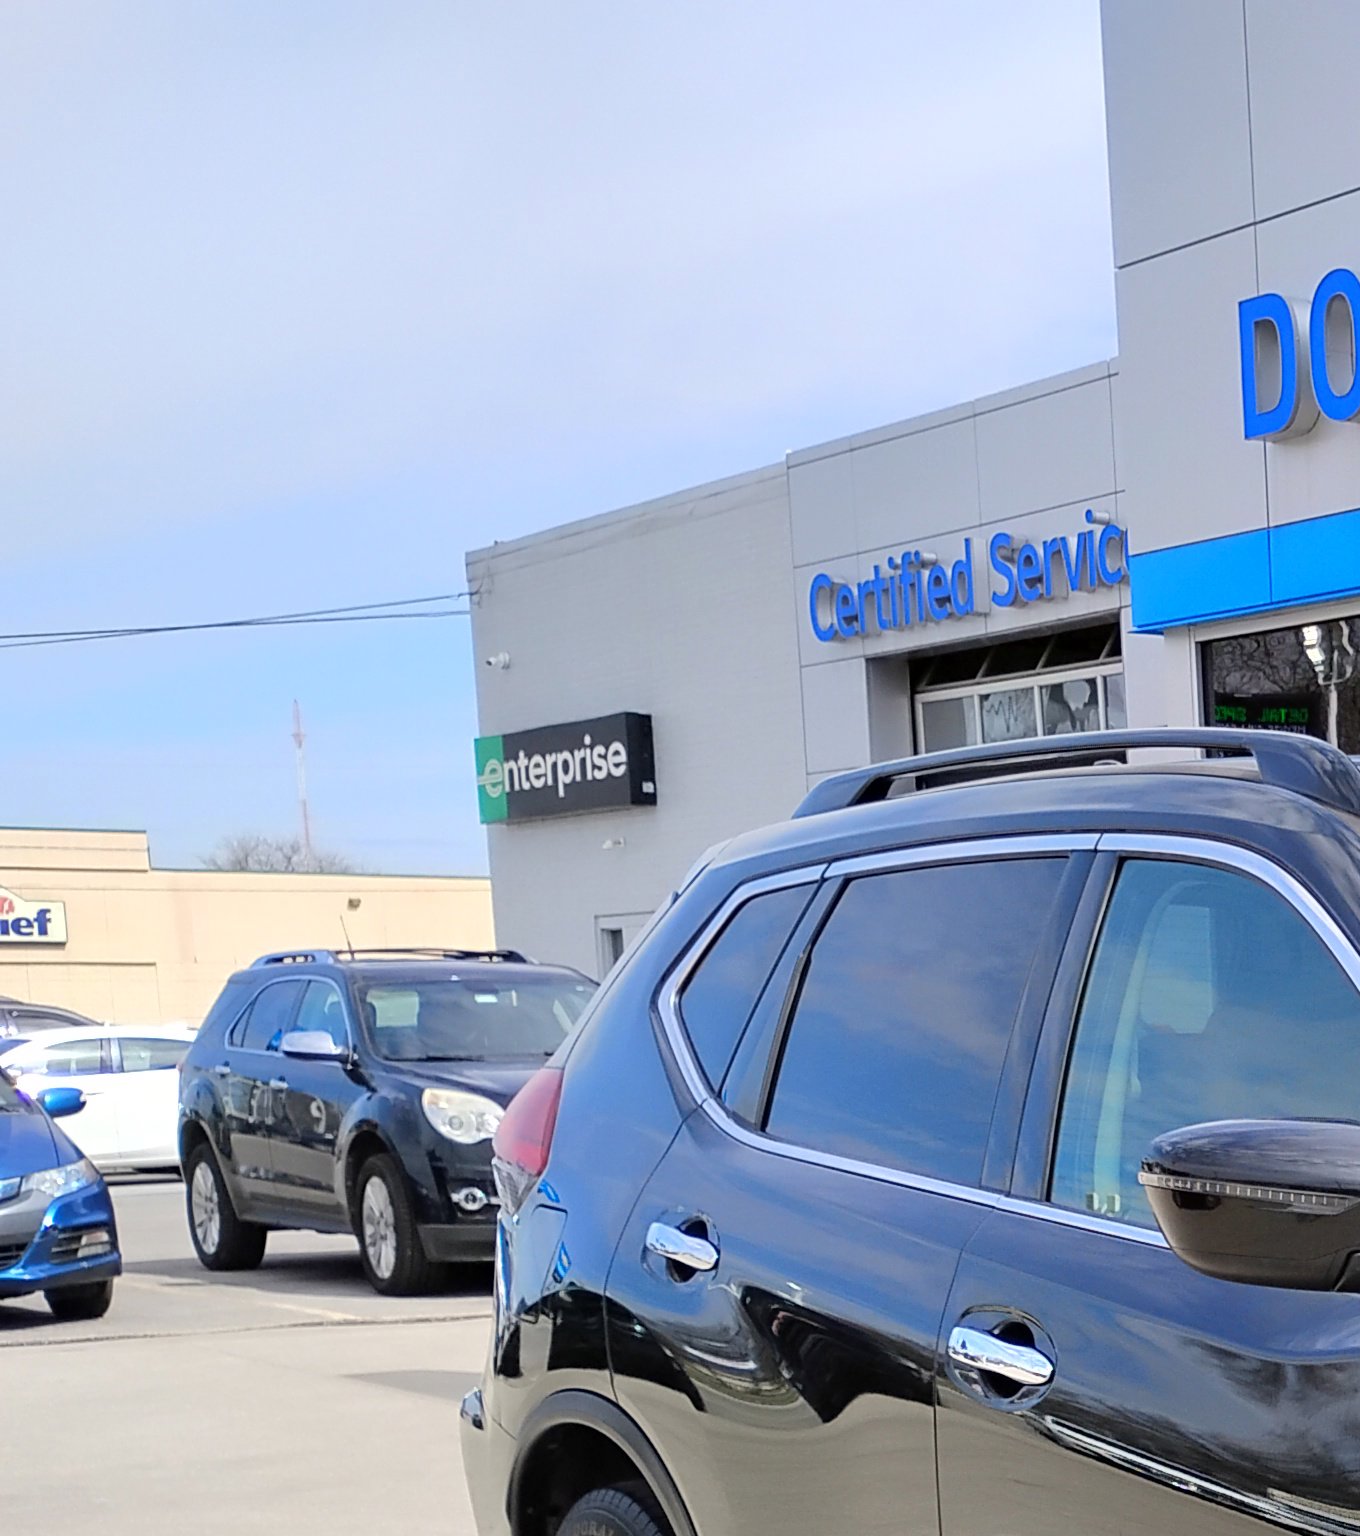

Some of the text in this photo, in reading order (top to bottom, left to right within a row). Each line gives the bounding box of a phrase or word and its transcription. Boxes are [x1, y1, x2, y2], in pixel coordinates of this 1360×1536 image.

[809, 508, 1130, 643] Certified Servic
[477, 733, 628, 798] enterprise
